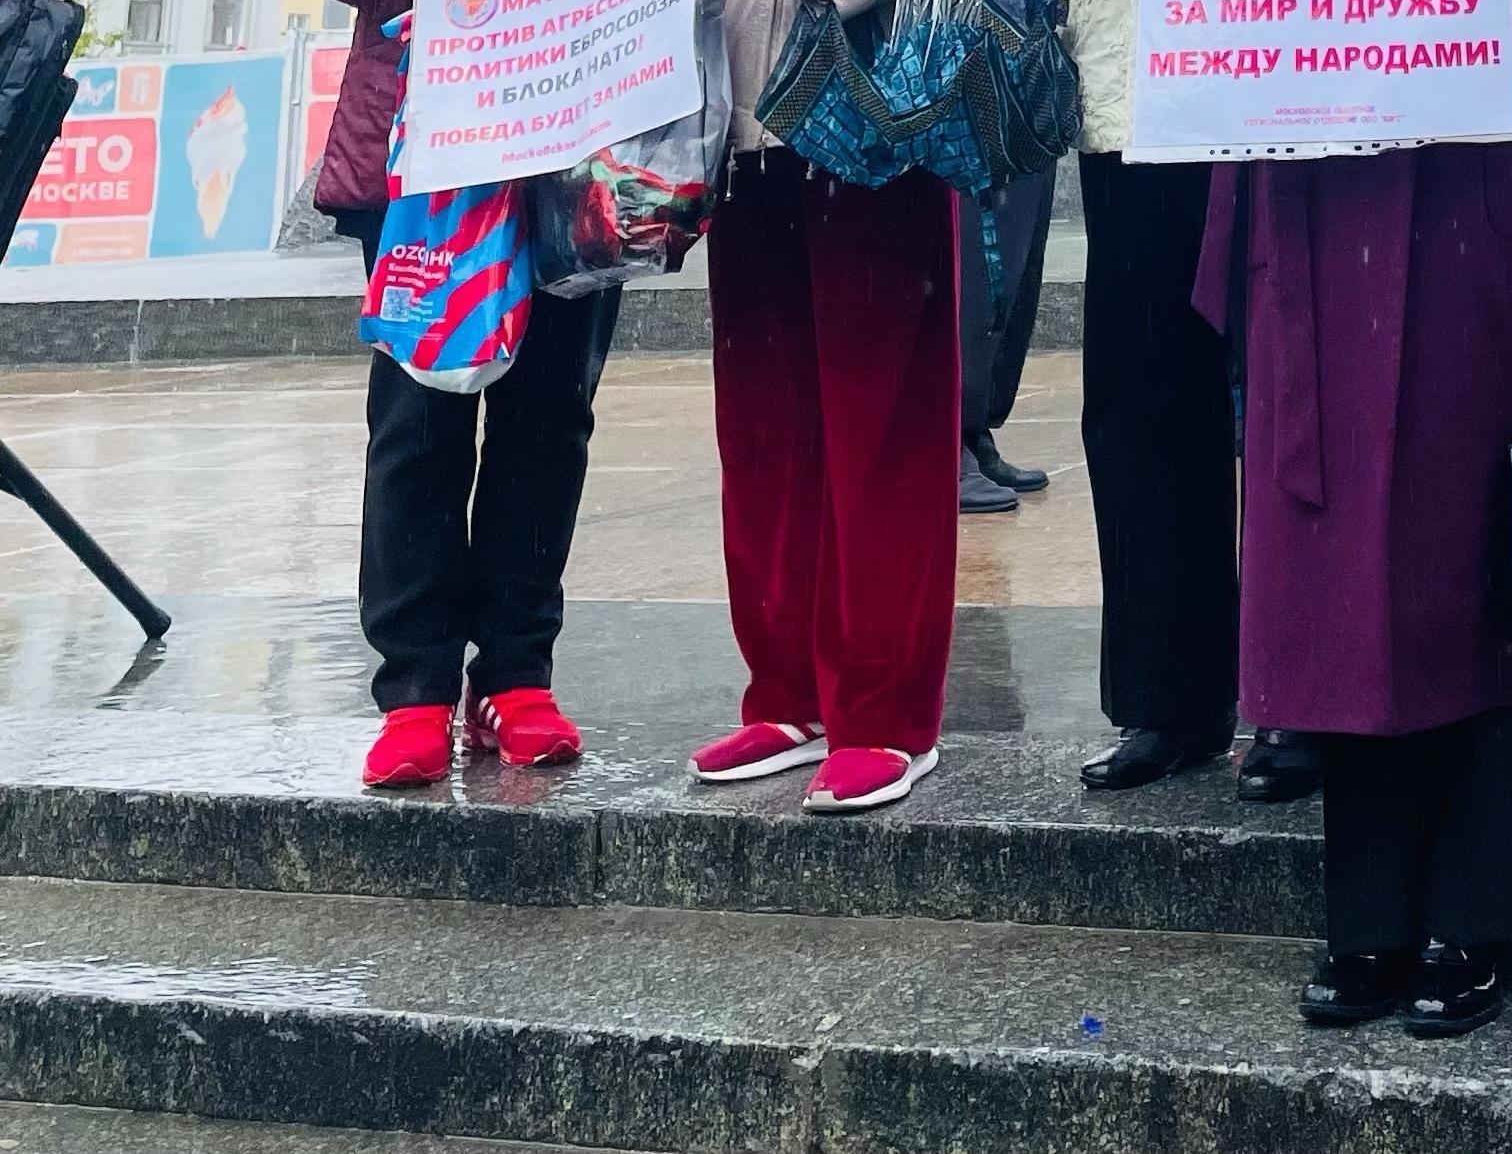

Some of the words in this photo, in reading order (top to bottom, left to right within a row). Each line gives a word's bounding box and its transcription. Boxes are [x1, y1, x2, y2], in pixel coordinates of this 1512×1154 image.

[1165, 1, 1208, 26] ЗА
[428, 23, 535, 56] ПРОТИВ
[1149, 48, 1282, 79] МЕЖДУ
[1295, 40, 1501, 75] НАРОДАМИ!
[426, 44, 566, 85] ПОЛИТИКИ
[430, 116, 525, 148] ПОБЕДА
[531, 99, 590, 133] БУДЕТ
[593, 87, 613, 109] ЗА
[617, 56, 674, 94] НАМИ!
[476, 90, 495, 108] И
[502, 68, 583, 104] БЛОКА
[38, 133, 134, 176] ЕТО
